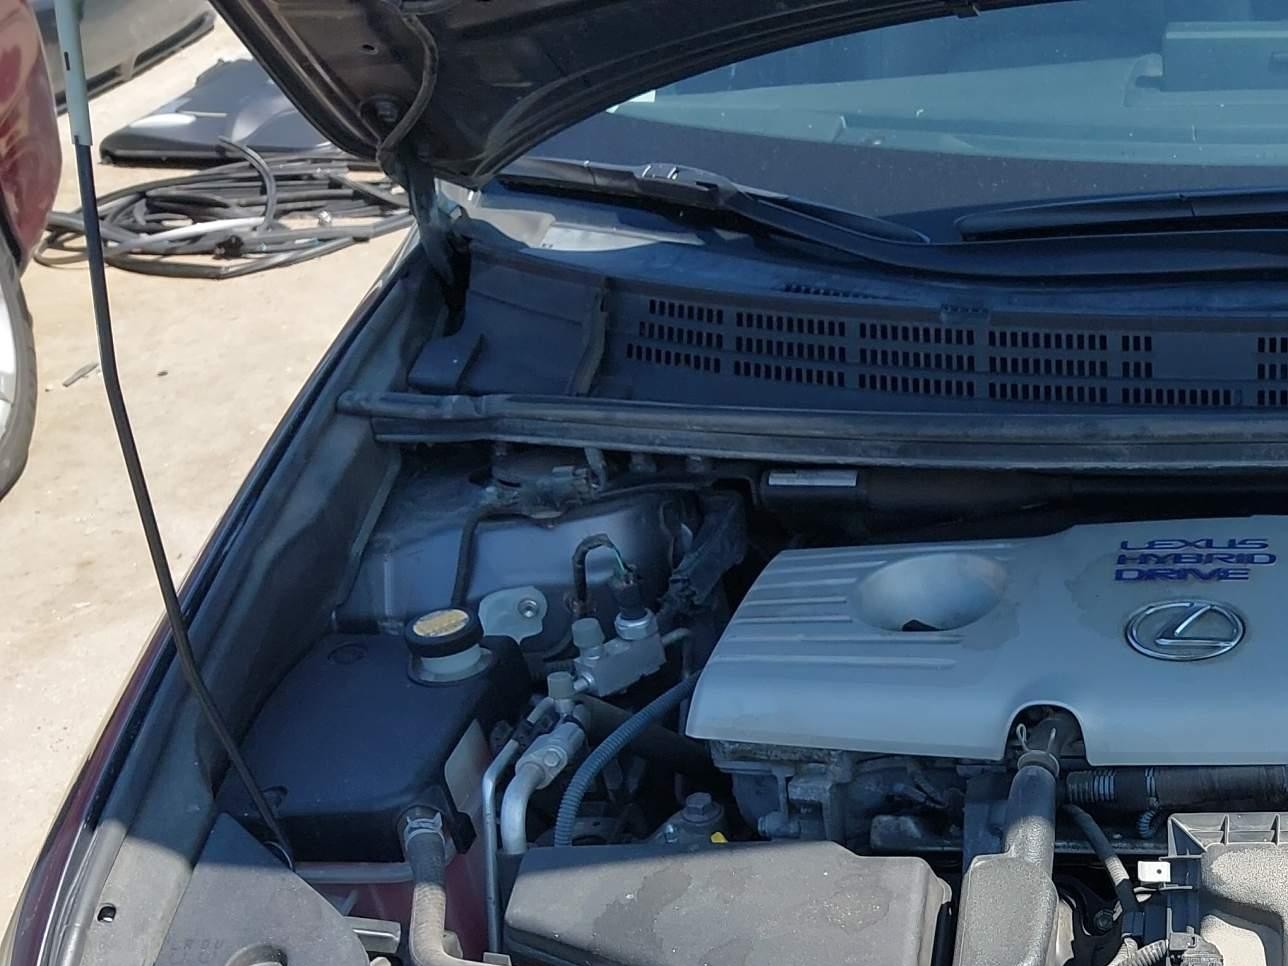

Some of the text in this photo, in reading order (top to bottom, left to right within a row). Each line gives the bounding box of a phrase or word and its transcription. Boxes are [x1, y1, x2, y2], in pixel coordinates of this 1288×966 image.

[1120, 538, 1269, 550] LEXUS
[1116, 553, 1277, 565] HYBRID
[1114, 567, 1251, 581] DRIVE
